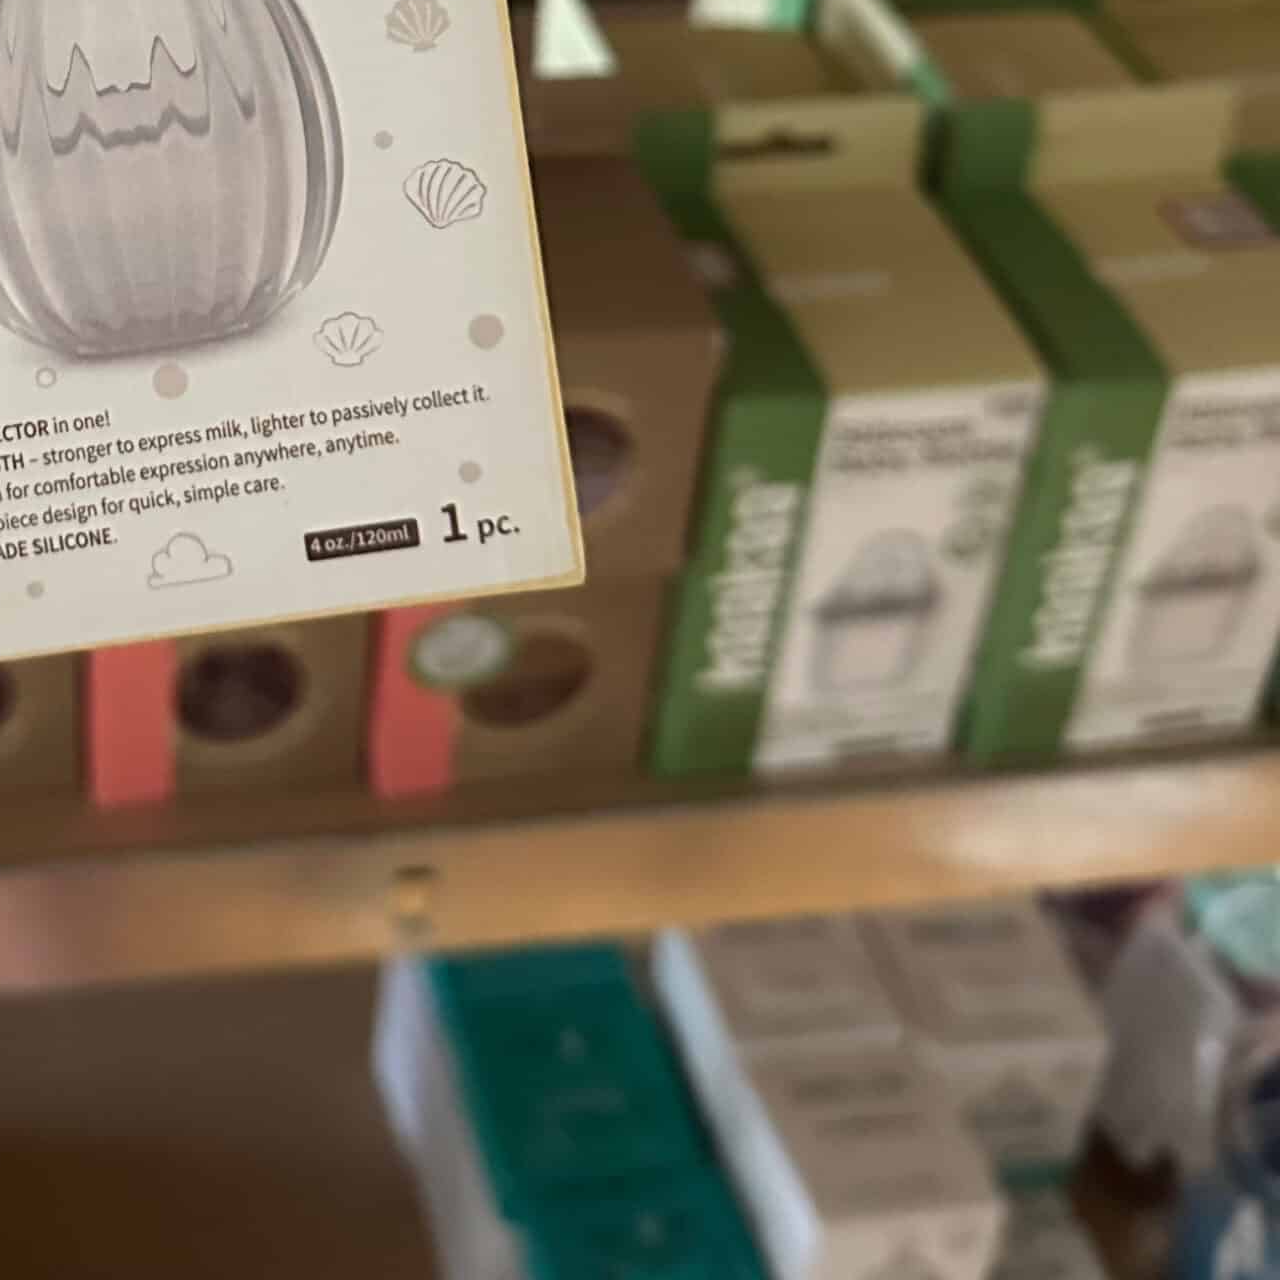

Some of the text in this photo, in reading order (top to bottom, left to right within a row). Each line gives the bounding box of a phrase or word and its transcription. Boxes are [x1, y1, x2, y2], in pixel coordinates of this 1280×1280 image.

[42, 441, 112, 468] stronger
[116, 438, 135, 455] to
[138, 430, 202, 453] express
[205, 417, 248, 442] milk,
[250, 412, 305, 438] lighter
[308, 409, 328, 426] to
[331, 395, 409, 427] passively
[412, 388, 468, 411] collect
[471, 383, 491, 402] it.
[52, 416, 69, 435] in
[73, 409, 111, 431] one!
[5, 481, 29, 500] for
[33, 465, 136, 496] comfortable
[139, 453, 230, 483] expression
[234, 442, 323, 469] anywhere,
[325, 428, 400, 456] anytime.
[42, 498, 98, 524] design
[100, 497, 125, 515] for
[128, 489, 181, 516] quick,
[183, 480, 240, 503] simple
[243, 476, 286, 494] care.
[32, 526, 119, 556] SILICONE.
[310, 503, 521, 554] 4 oz./120ml 1 pc.
